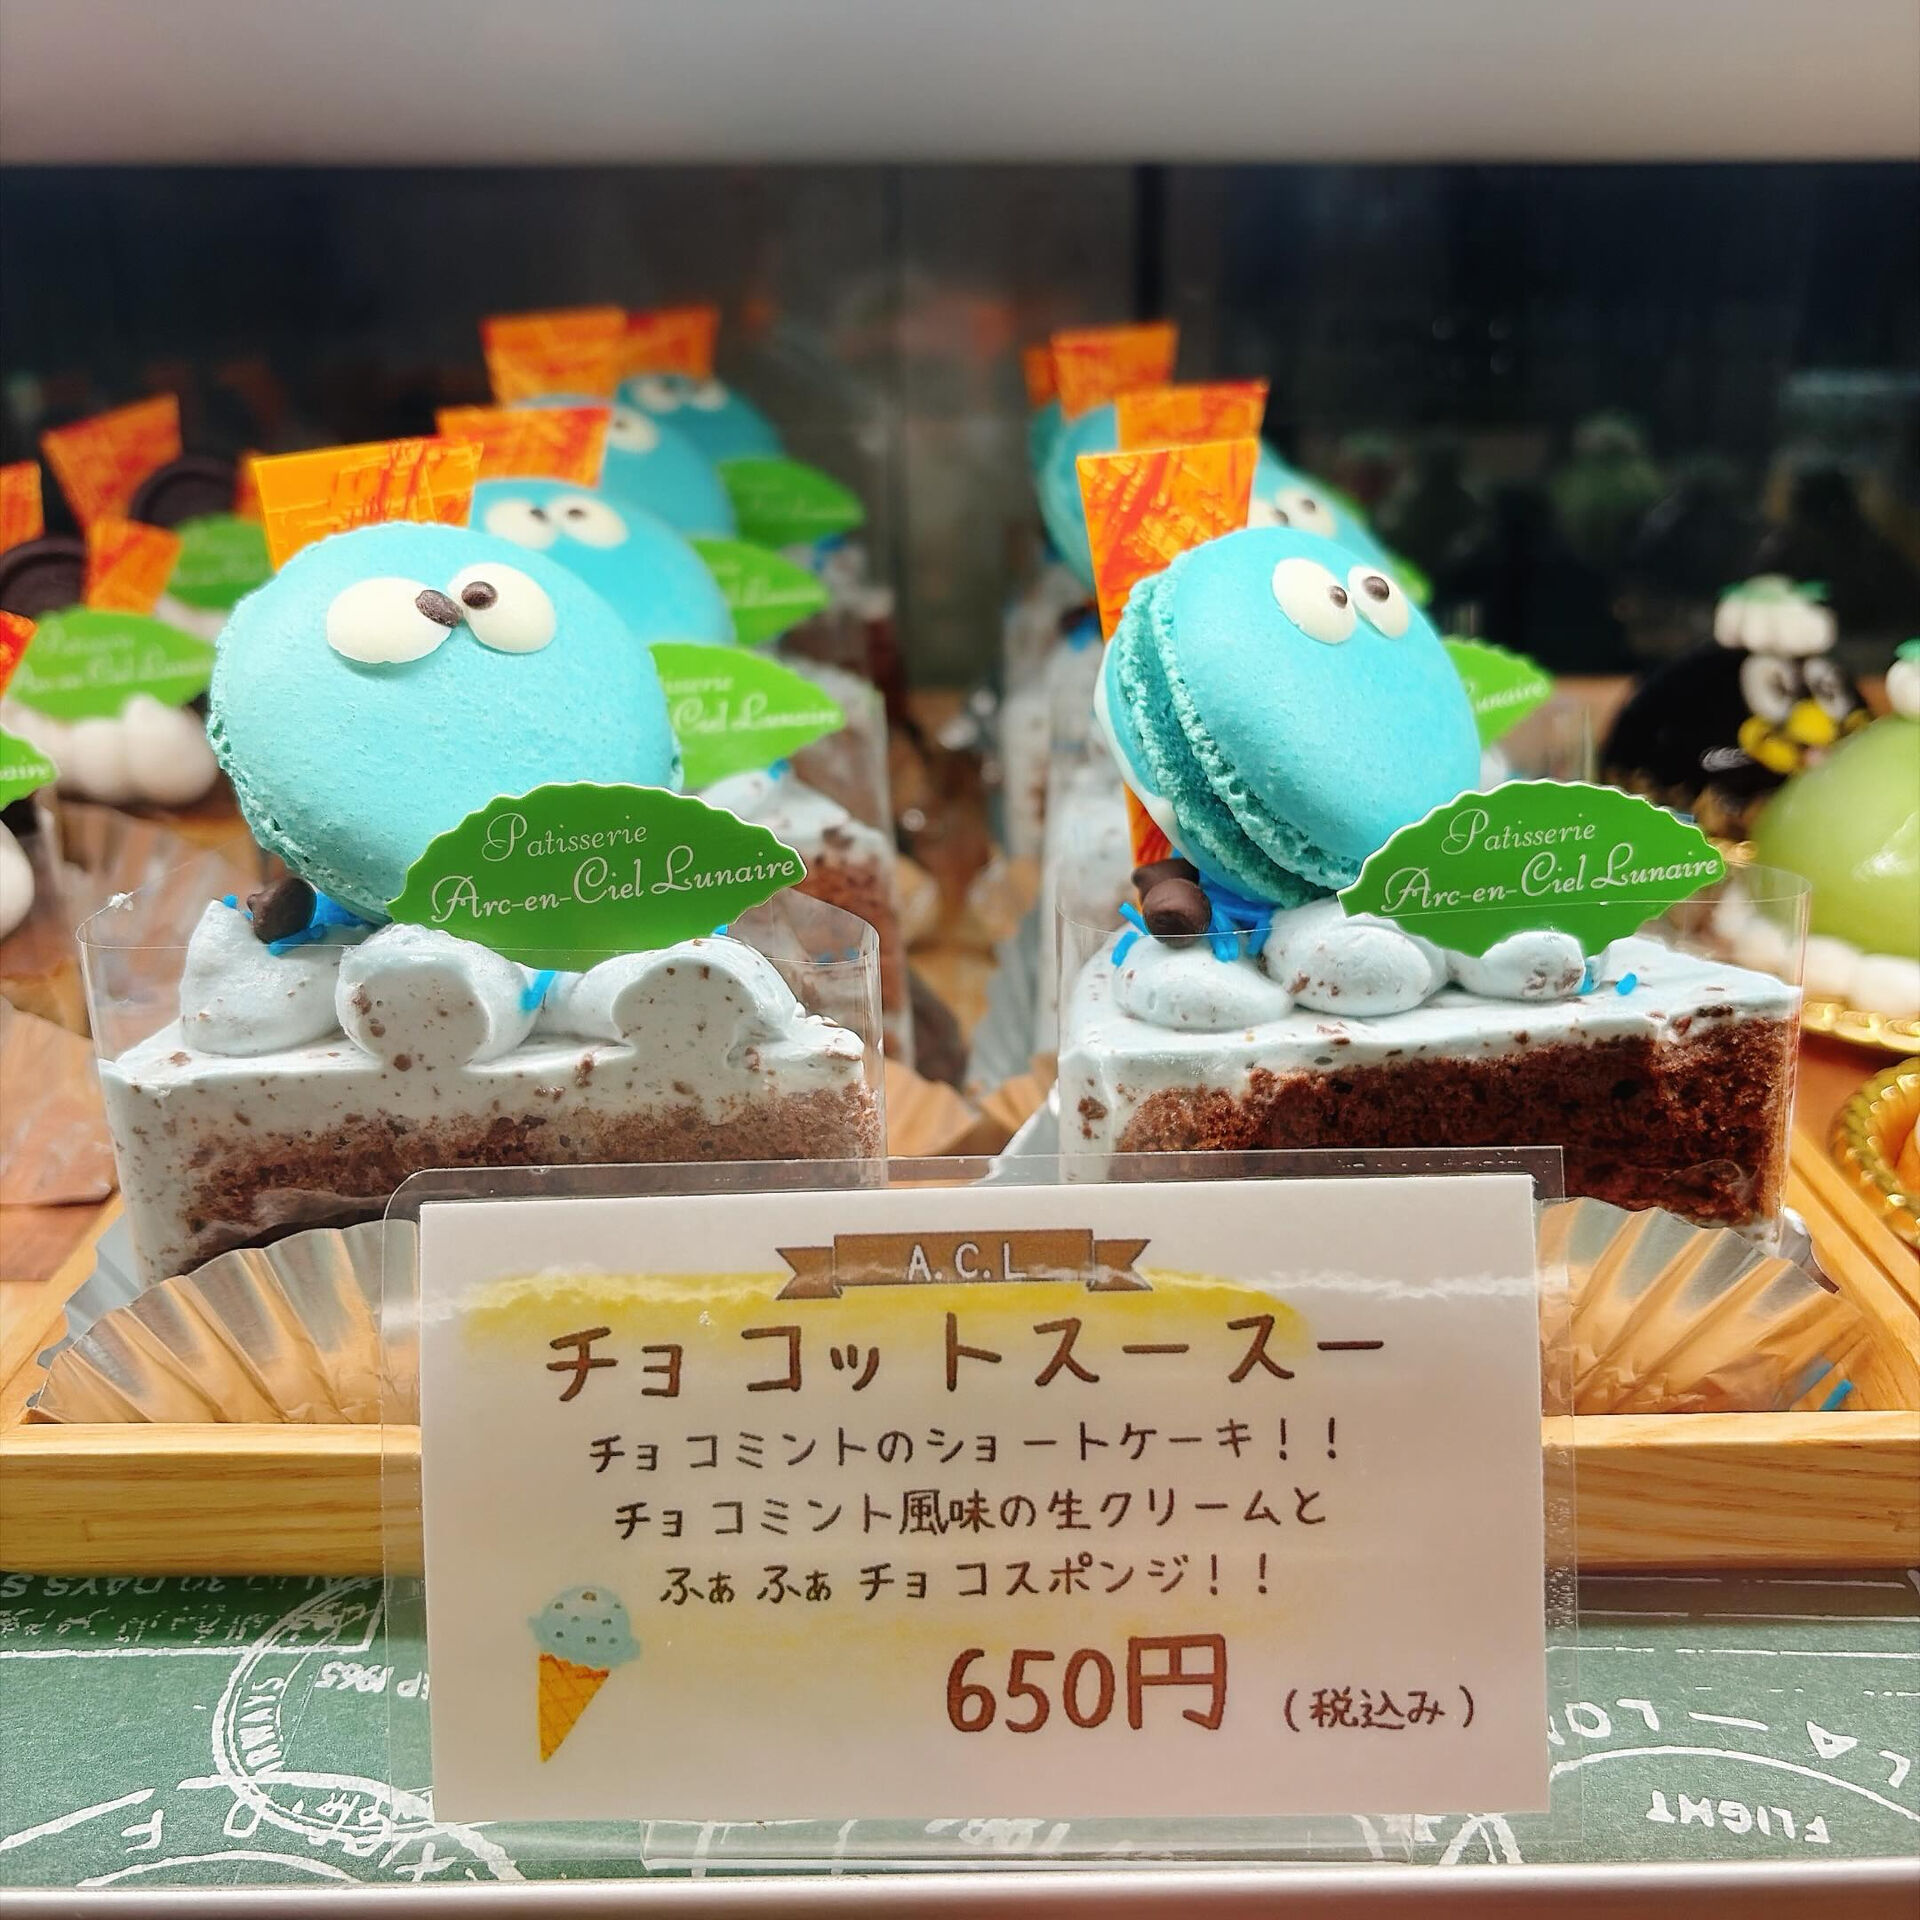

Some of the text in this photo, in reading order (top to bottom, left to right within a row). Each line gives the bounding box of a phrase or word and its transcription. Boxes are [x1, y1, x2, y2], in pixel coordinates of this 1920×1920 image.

[481, 811, 648, 862] Patisserie
[1440, 808, 1596, 855] Patisserie
[430, 845, 796, 923] Arc-en-Ciel Lunaire
[1380, 842, 1718, 913] Arc-en-Ciel Lunaire
[546, 1311, 1385, 1401] チョコットスースー
[589, 1416, 1337, 1473] チョコミントのショートケーキ！！
[614, 1487, 1326, 1540] チョコミント風味の生クリームと
[946, 1633, 1226, 1733] 650円
[1645, 1789, 1831, 1844] FLIGHT
